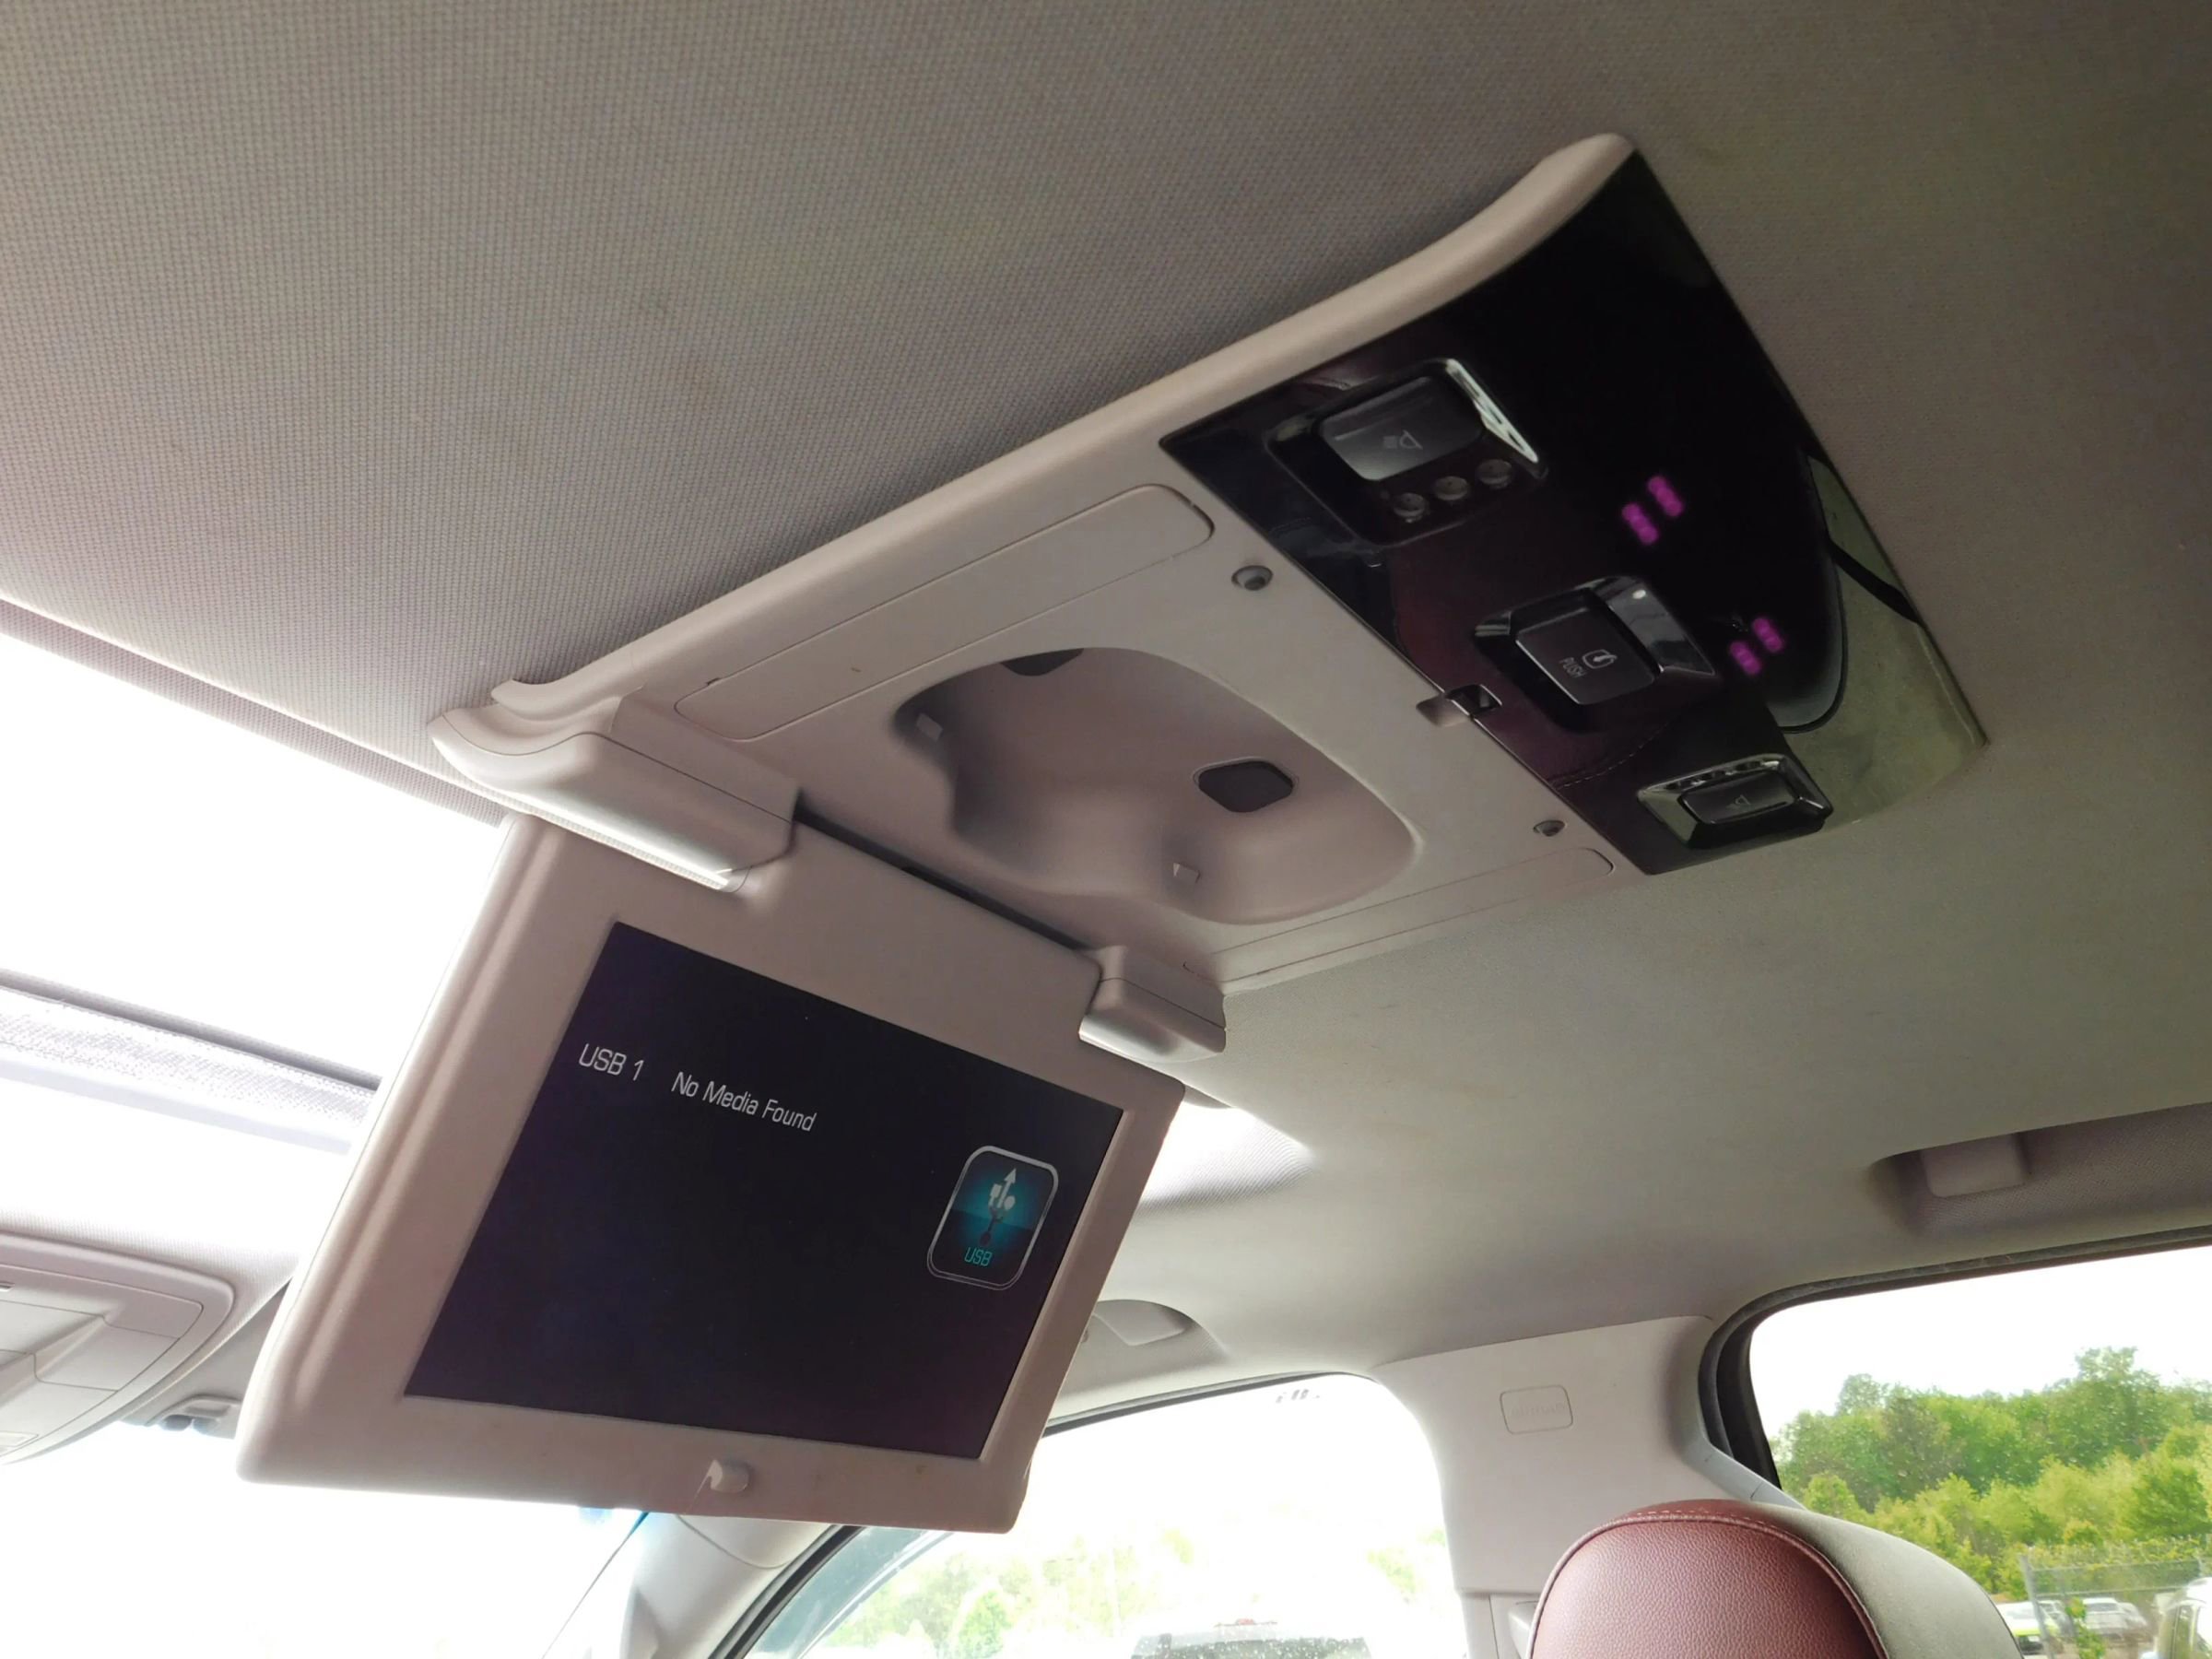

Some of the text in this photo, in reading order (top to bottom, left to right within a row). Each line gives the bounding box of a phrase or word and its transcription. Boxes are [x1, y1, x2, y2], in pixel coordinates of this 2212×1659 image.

[1559, 657, 1586, 677] PUSH
[578, 1042, 817, 1132] USB 1 No Media Found
[964, 1246, 993, 1267] USB
